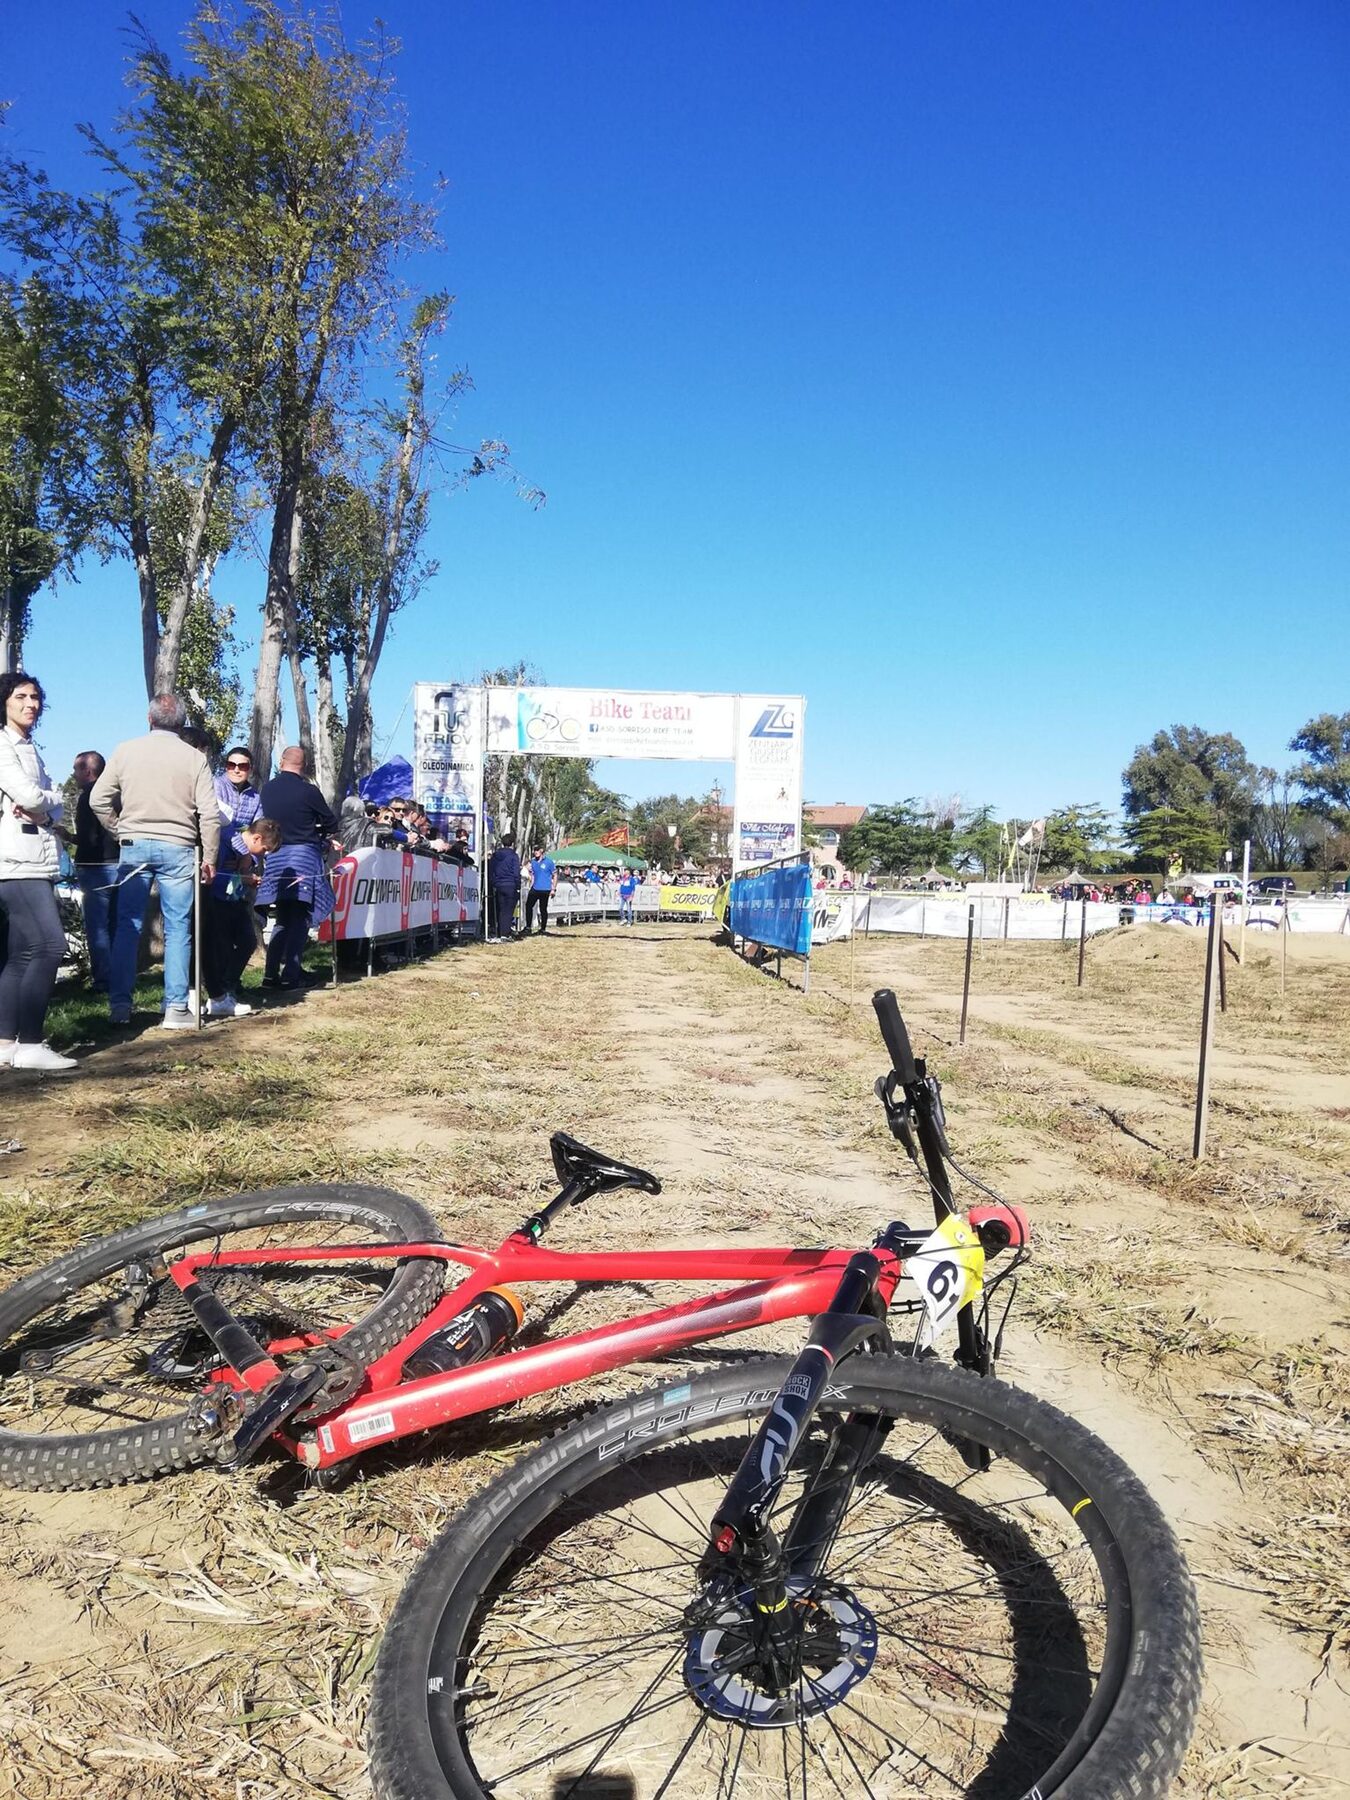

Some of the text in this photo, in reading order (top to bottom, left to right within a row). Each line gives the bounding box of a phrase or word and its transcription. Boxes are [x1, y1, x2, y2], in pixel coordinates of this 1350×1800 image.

[588, 698, 691, 721] Bike Team
[422, 761, 475, 772] OLEODINAMICA
[354, 879, 400, 905] OLYMPIA
[671, 893, 716, 906] SORRISO
[264, 1202, 400, 1232] CROSSMAX
[599, 1384, 853, 1461] CROSSMX
[469, 1396, 656, 1534] SCHWALBE
